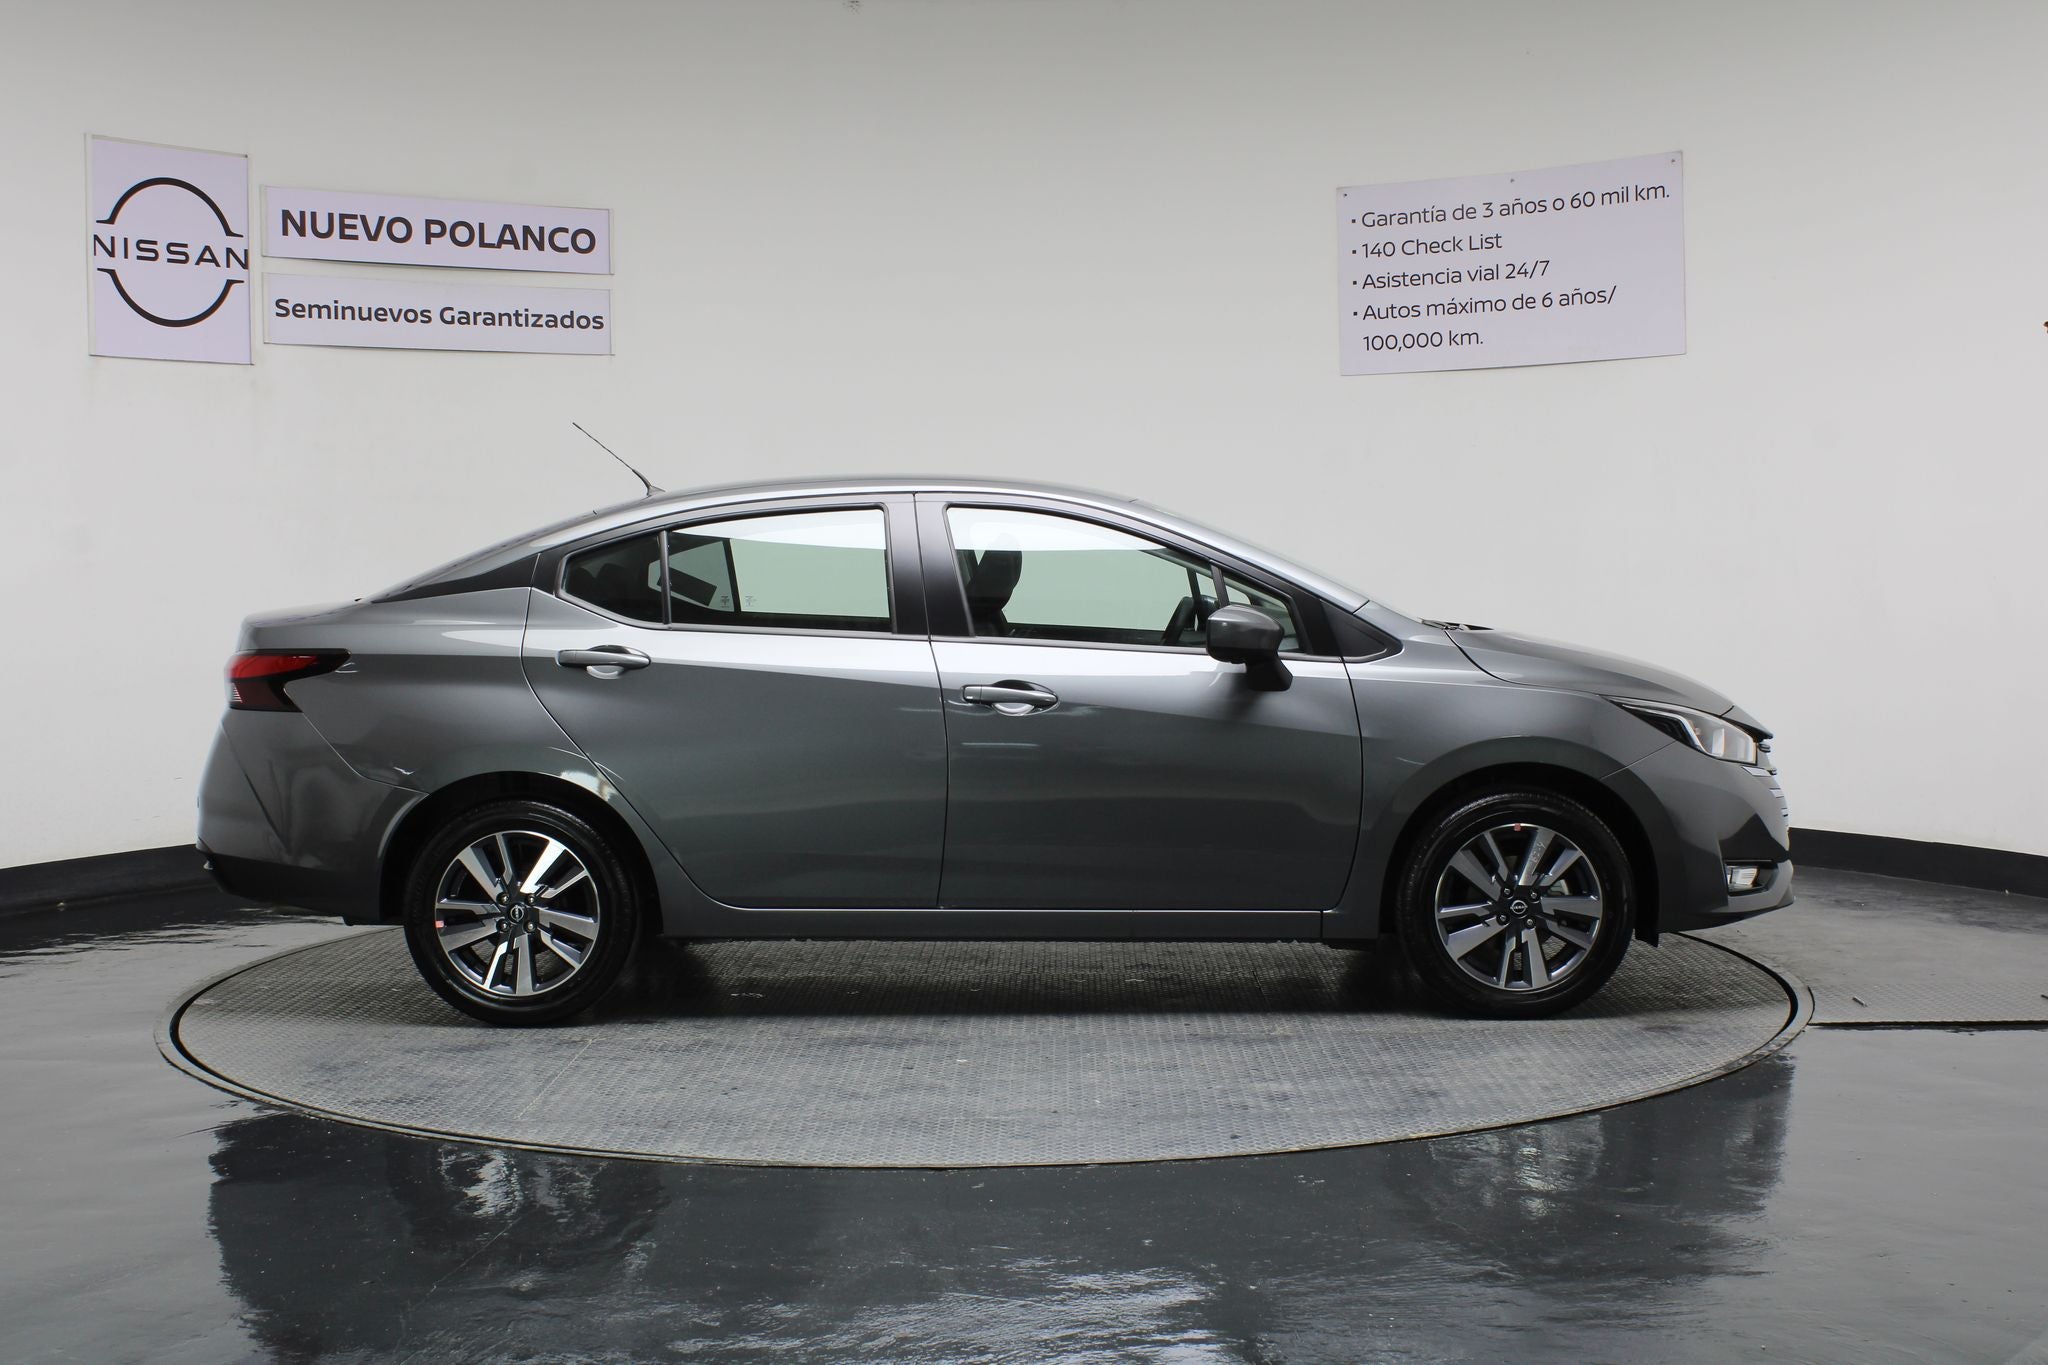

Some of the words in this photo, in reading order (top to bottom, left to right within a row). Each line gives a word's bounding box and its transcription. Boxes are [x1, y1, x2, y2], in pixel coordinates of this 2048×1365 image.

[1361, 205, 1447, 228] Garantía
[1452, 203, 1477, 221] de
[1482, 201, 1494, 219] 3
[1499, 198, 1548, 217] años
[1552, 197, 1565, 211] o
[1570, 190, 1596, 210] 60
[1601, 185, 1629, 206] mil
[1635, 182, 1670, 202] km.
[281, 209, 413, 244] NUEVO
[424, 218, 596, 255] POLANCO
[1361, 241, 1396, 259] 140
[1401, 235, 1464, 256] Check
[1469, 233, 1503, 251] List
[93, 233, 249, 270] NISSAN
[1361, 267, 1462, 290] Asistencia
[1466, 263, 1499, 282] vial
[1505, 259, 1550, 280] 24/7
[275, 298, 433, 324] Seminuevos
[439, 306, 605, 330] Garantizados
[1362, 303, 1421, 321] Autos
[1426, 297, 1507, 317] máximo
[1511, 293, 1537, 311] de
[1541, 291, 1554, 308] 6
[1558, 285, 1617, 307] años/
[1362, 331, 1443, 353] 100,000
[1448, 329, 1484, 347] km.
